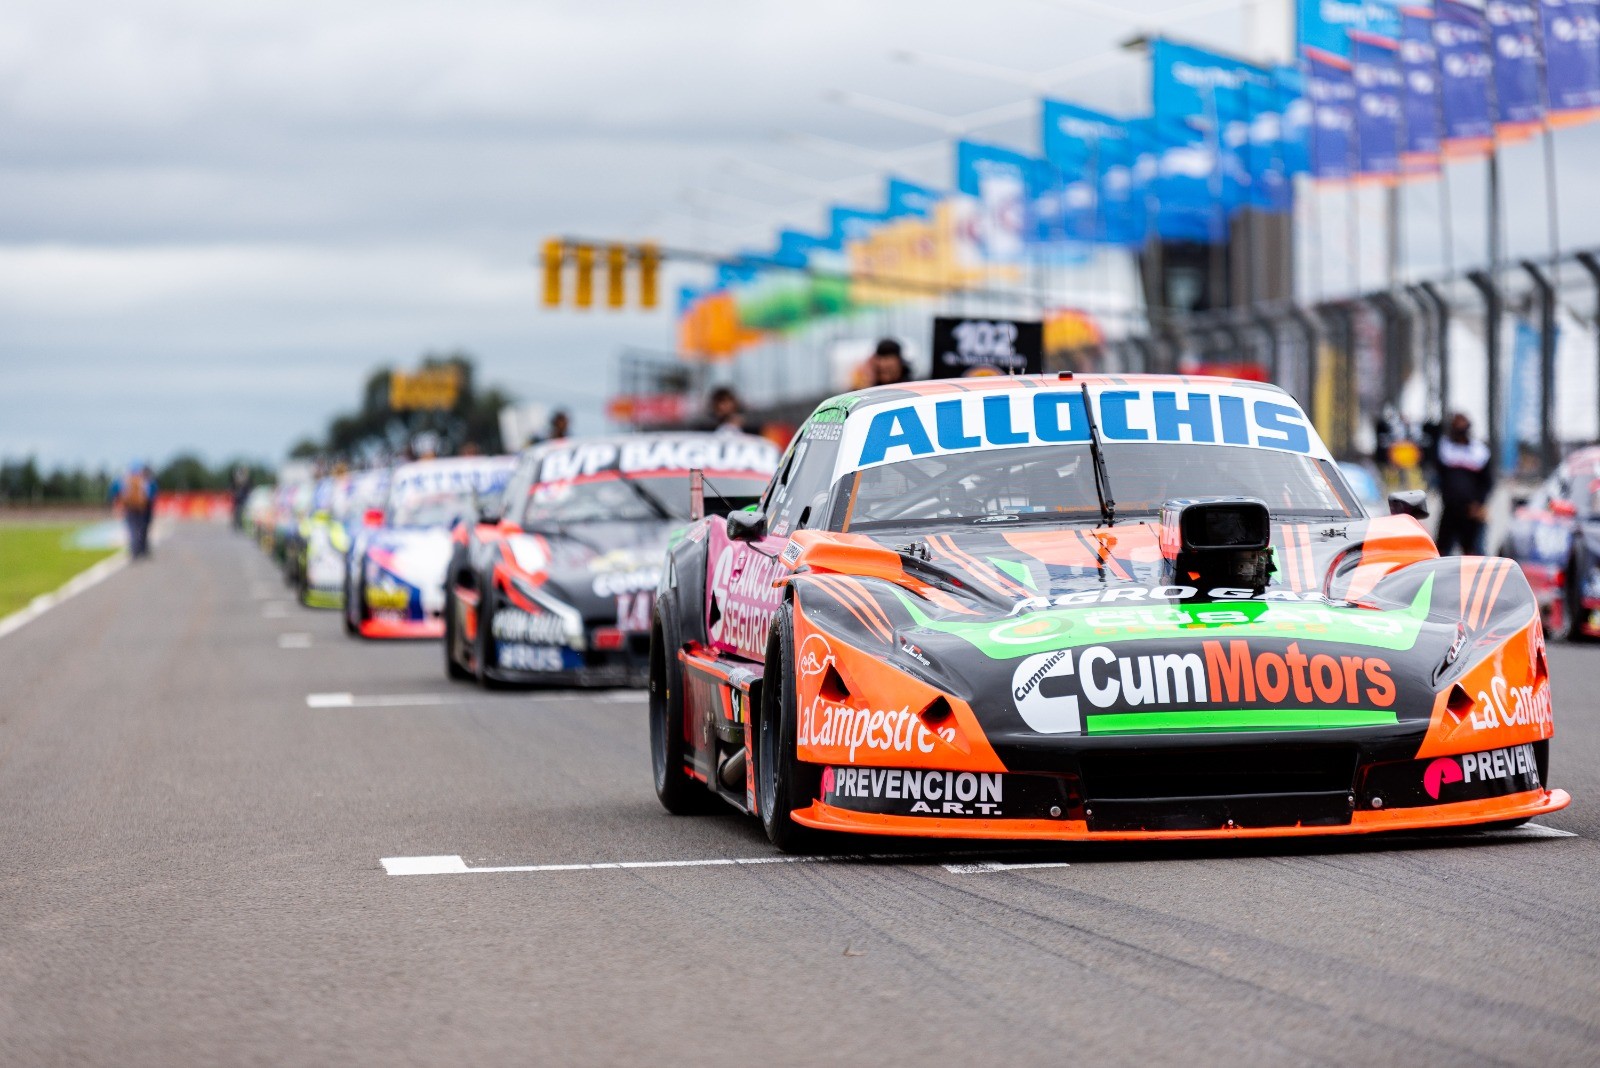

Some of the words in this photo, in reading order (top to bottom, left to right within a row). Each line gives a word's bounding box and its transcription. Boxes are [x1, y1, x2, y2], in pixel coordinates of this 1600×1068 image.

[952, 321, 1018, 354] 102
[858, 391, 1311, 467] ALLOCHIS
[728, 550, 788, 605] SANCOR
[1006, 585, 1199, 617] AGRO
[1014, 650, 1067, 702] Cummins
[1078, 640, 1397, 708] CumMotors
[835, 767, 1003, 803] PREVENCION
[910, 801, 1003, 816] A.R.T.
